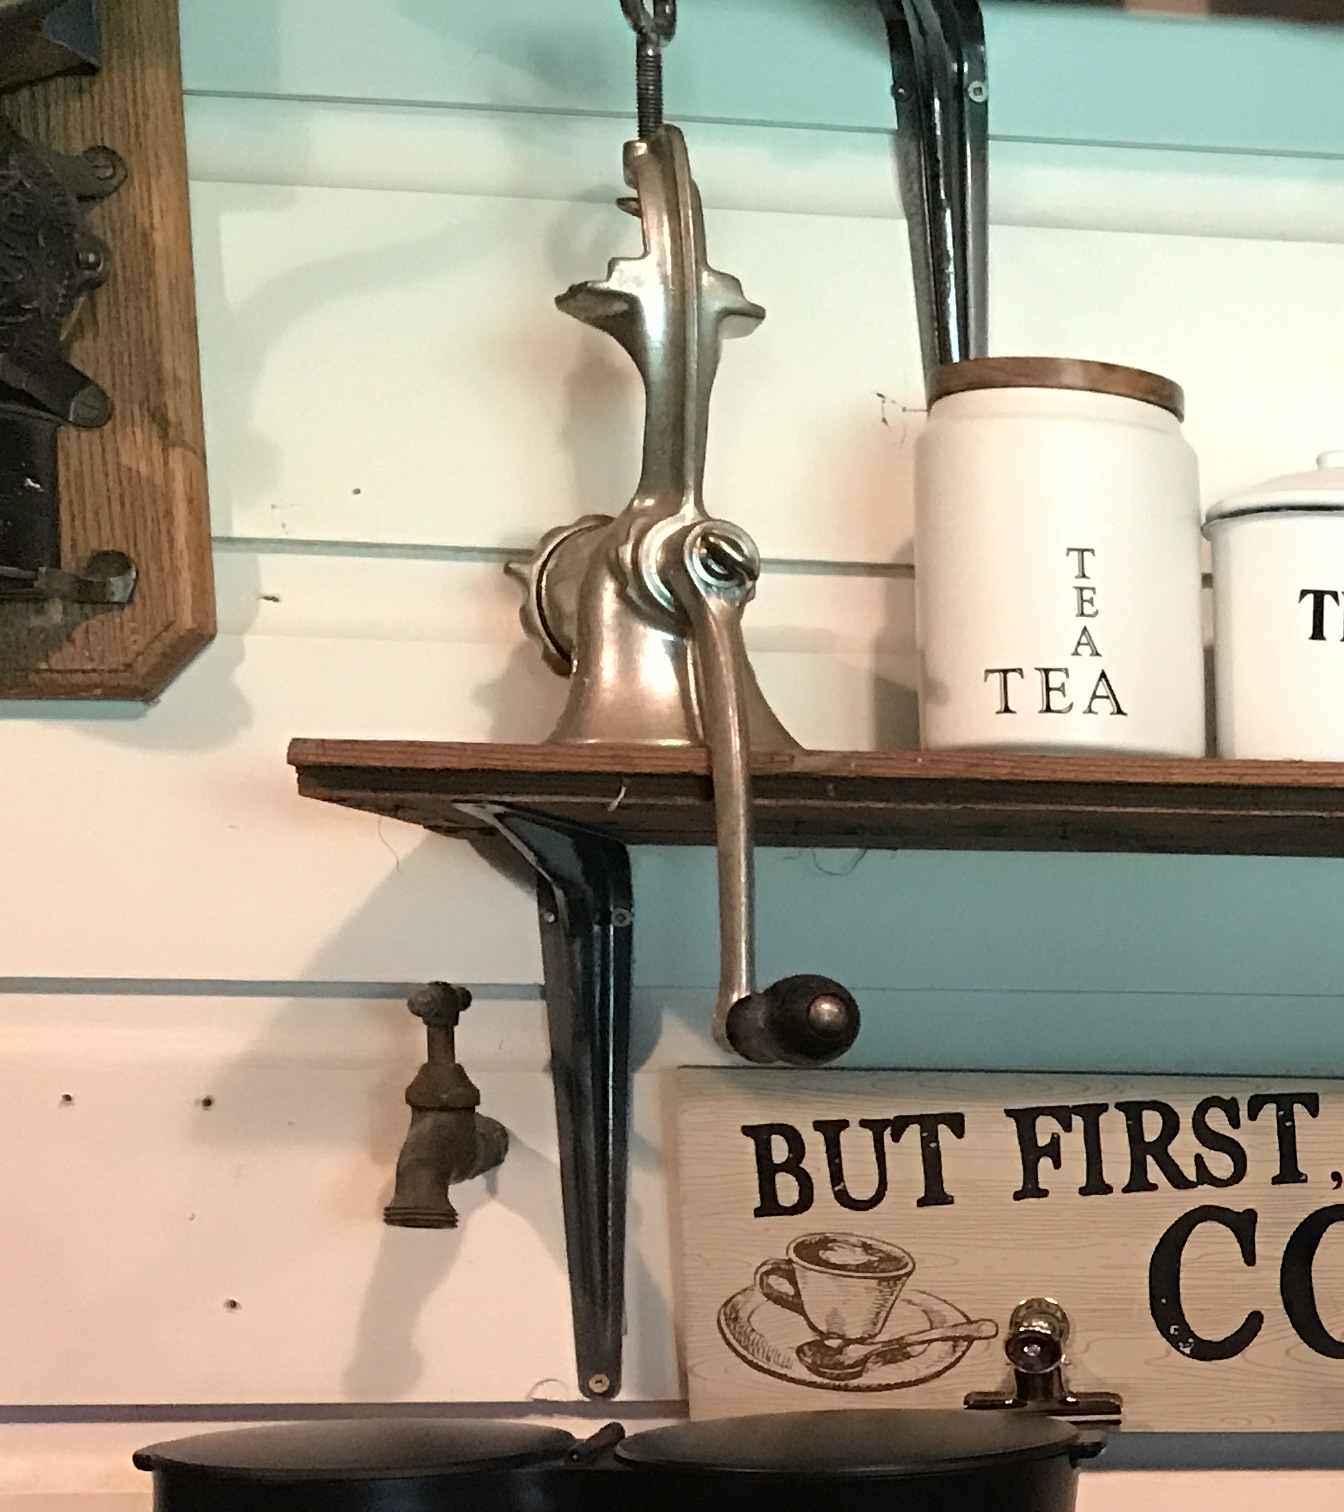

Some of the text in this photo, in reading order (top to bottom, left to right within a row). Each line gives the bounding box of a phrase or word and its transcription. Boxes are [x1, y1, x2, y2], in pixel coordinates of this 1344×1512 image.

[1065, 547, 1103, 658] TEA
[984, 667, 1128, 718] TEA
[740, 1091, 1343, 1219] BUT FIRST,
